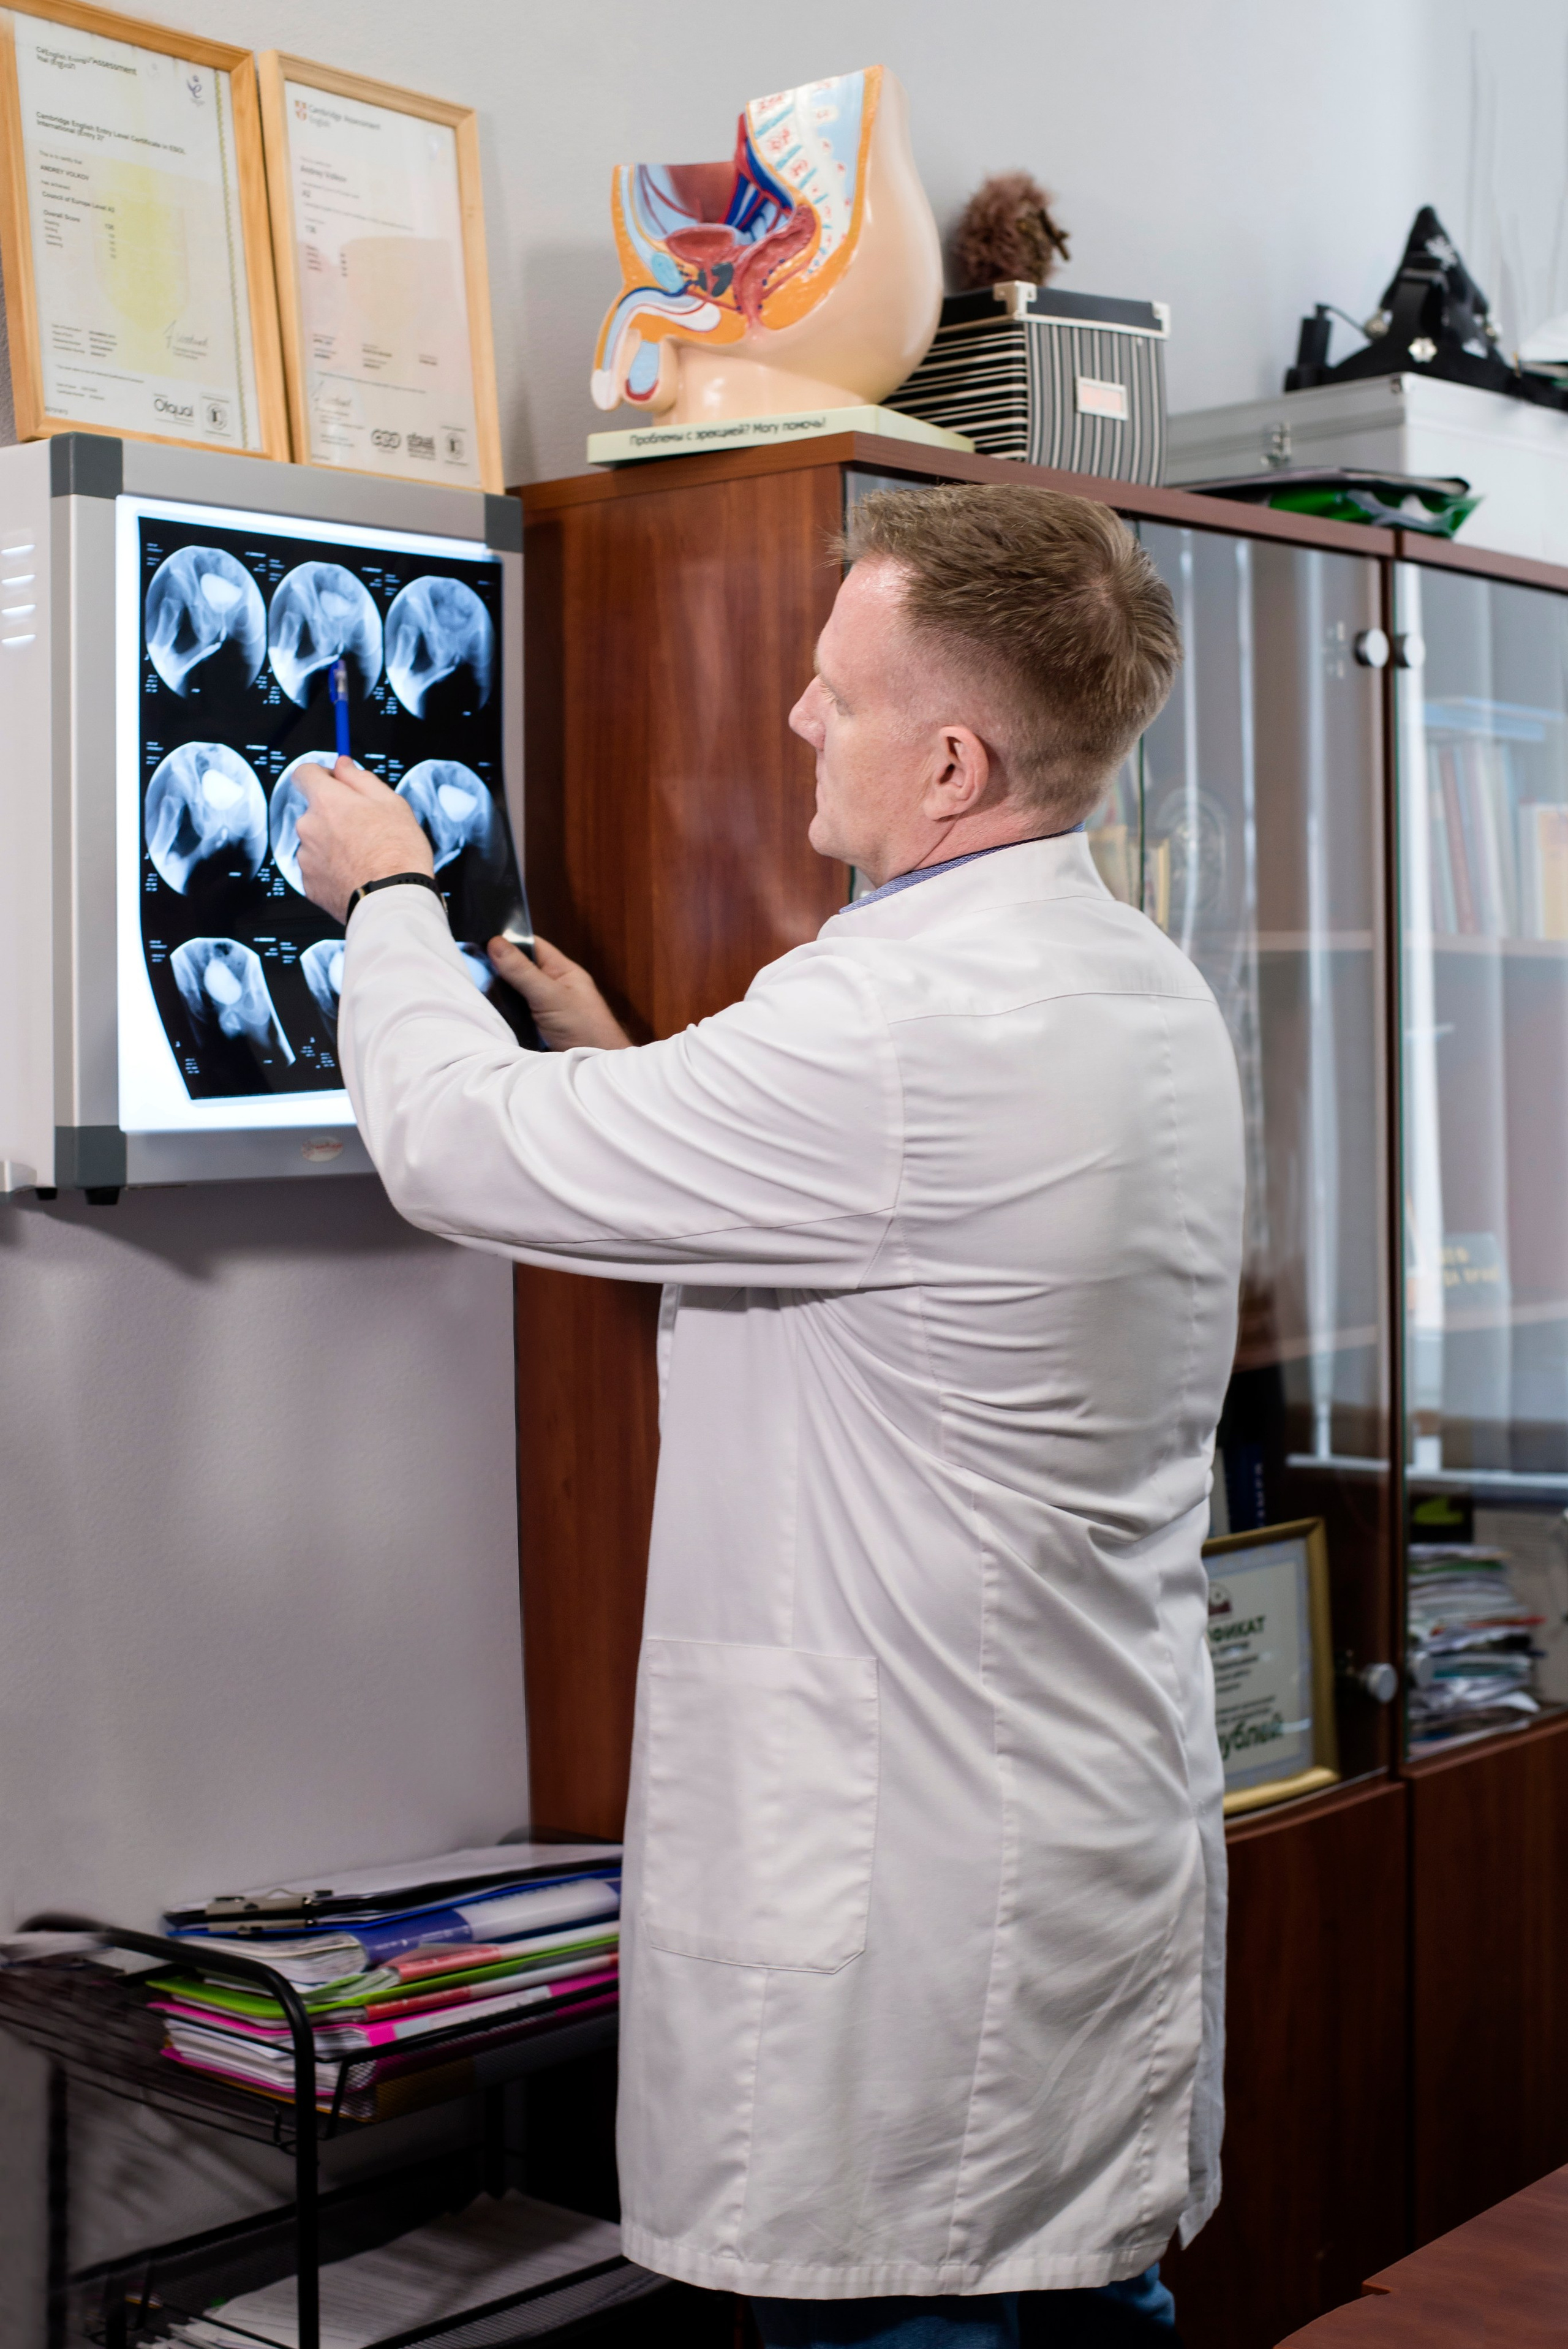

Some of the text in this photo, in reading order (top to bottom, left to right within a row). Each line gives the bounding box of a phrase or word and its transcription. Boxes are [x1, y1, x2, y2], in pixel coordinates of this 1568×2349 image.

[630, 432, 684, 447] Проблемы
[695, 423, 751, 440] эрекцией?
[752, 422, 780, 435] Могу
[783, 417, 826, 430] помочь!
